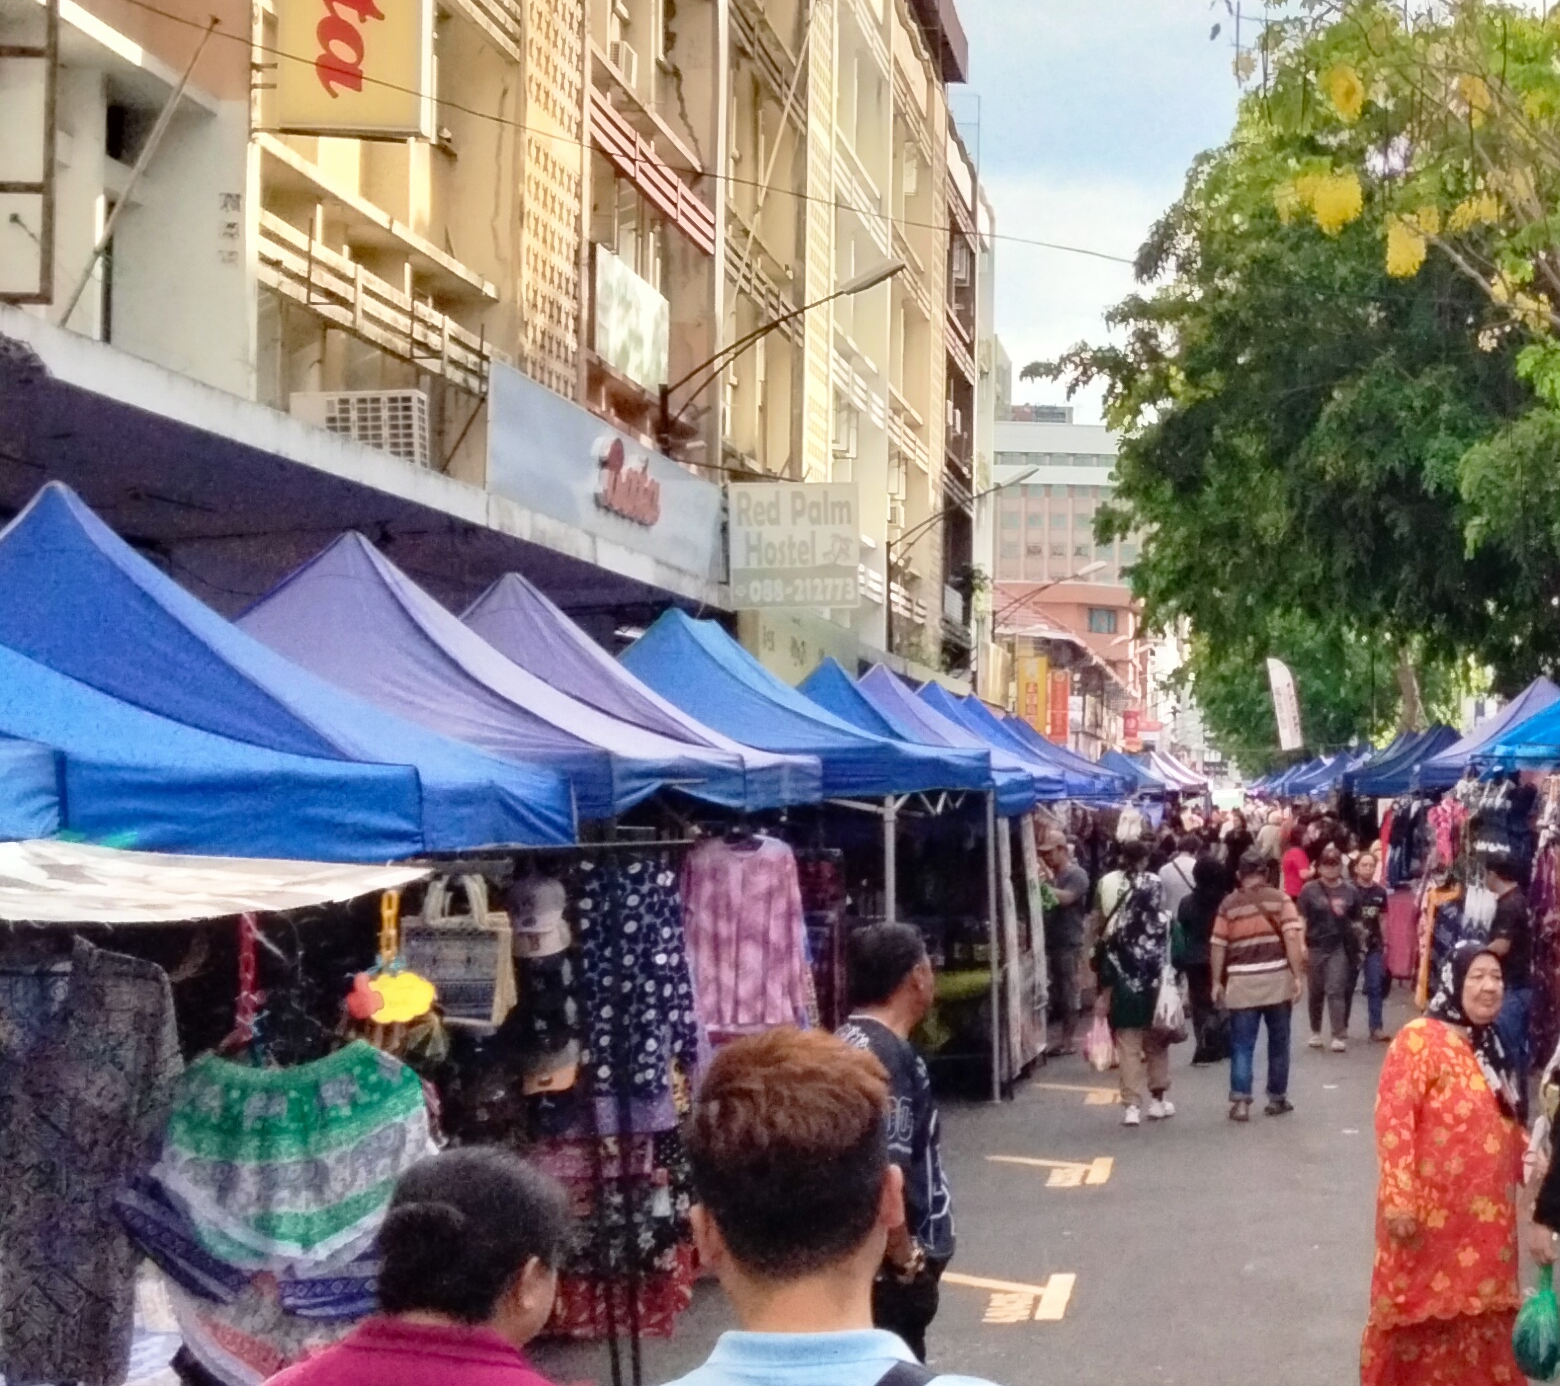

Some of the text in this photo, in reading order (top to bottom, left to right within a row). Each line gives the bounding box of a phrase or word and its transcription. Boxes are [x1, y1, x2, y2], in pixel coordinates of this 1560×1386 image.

[736, 489, 853, 527] Red Palm
[744, 530, 816, 566] Hostel
[750, 576, 856, 603] 088-212773
